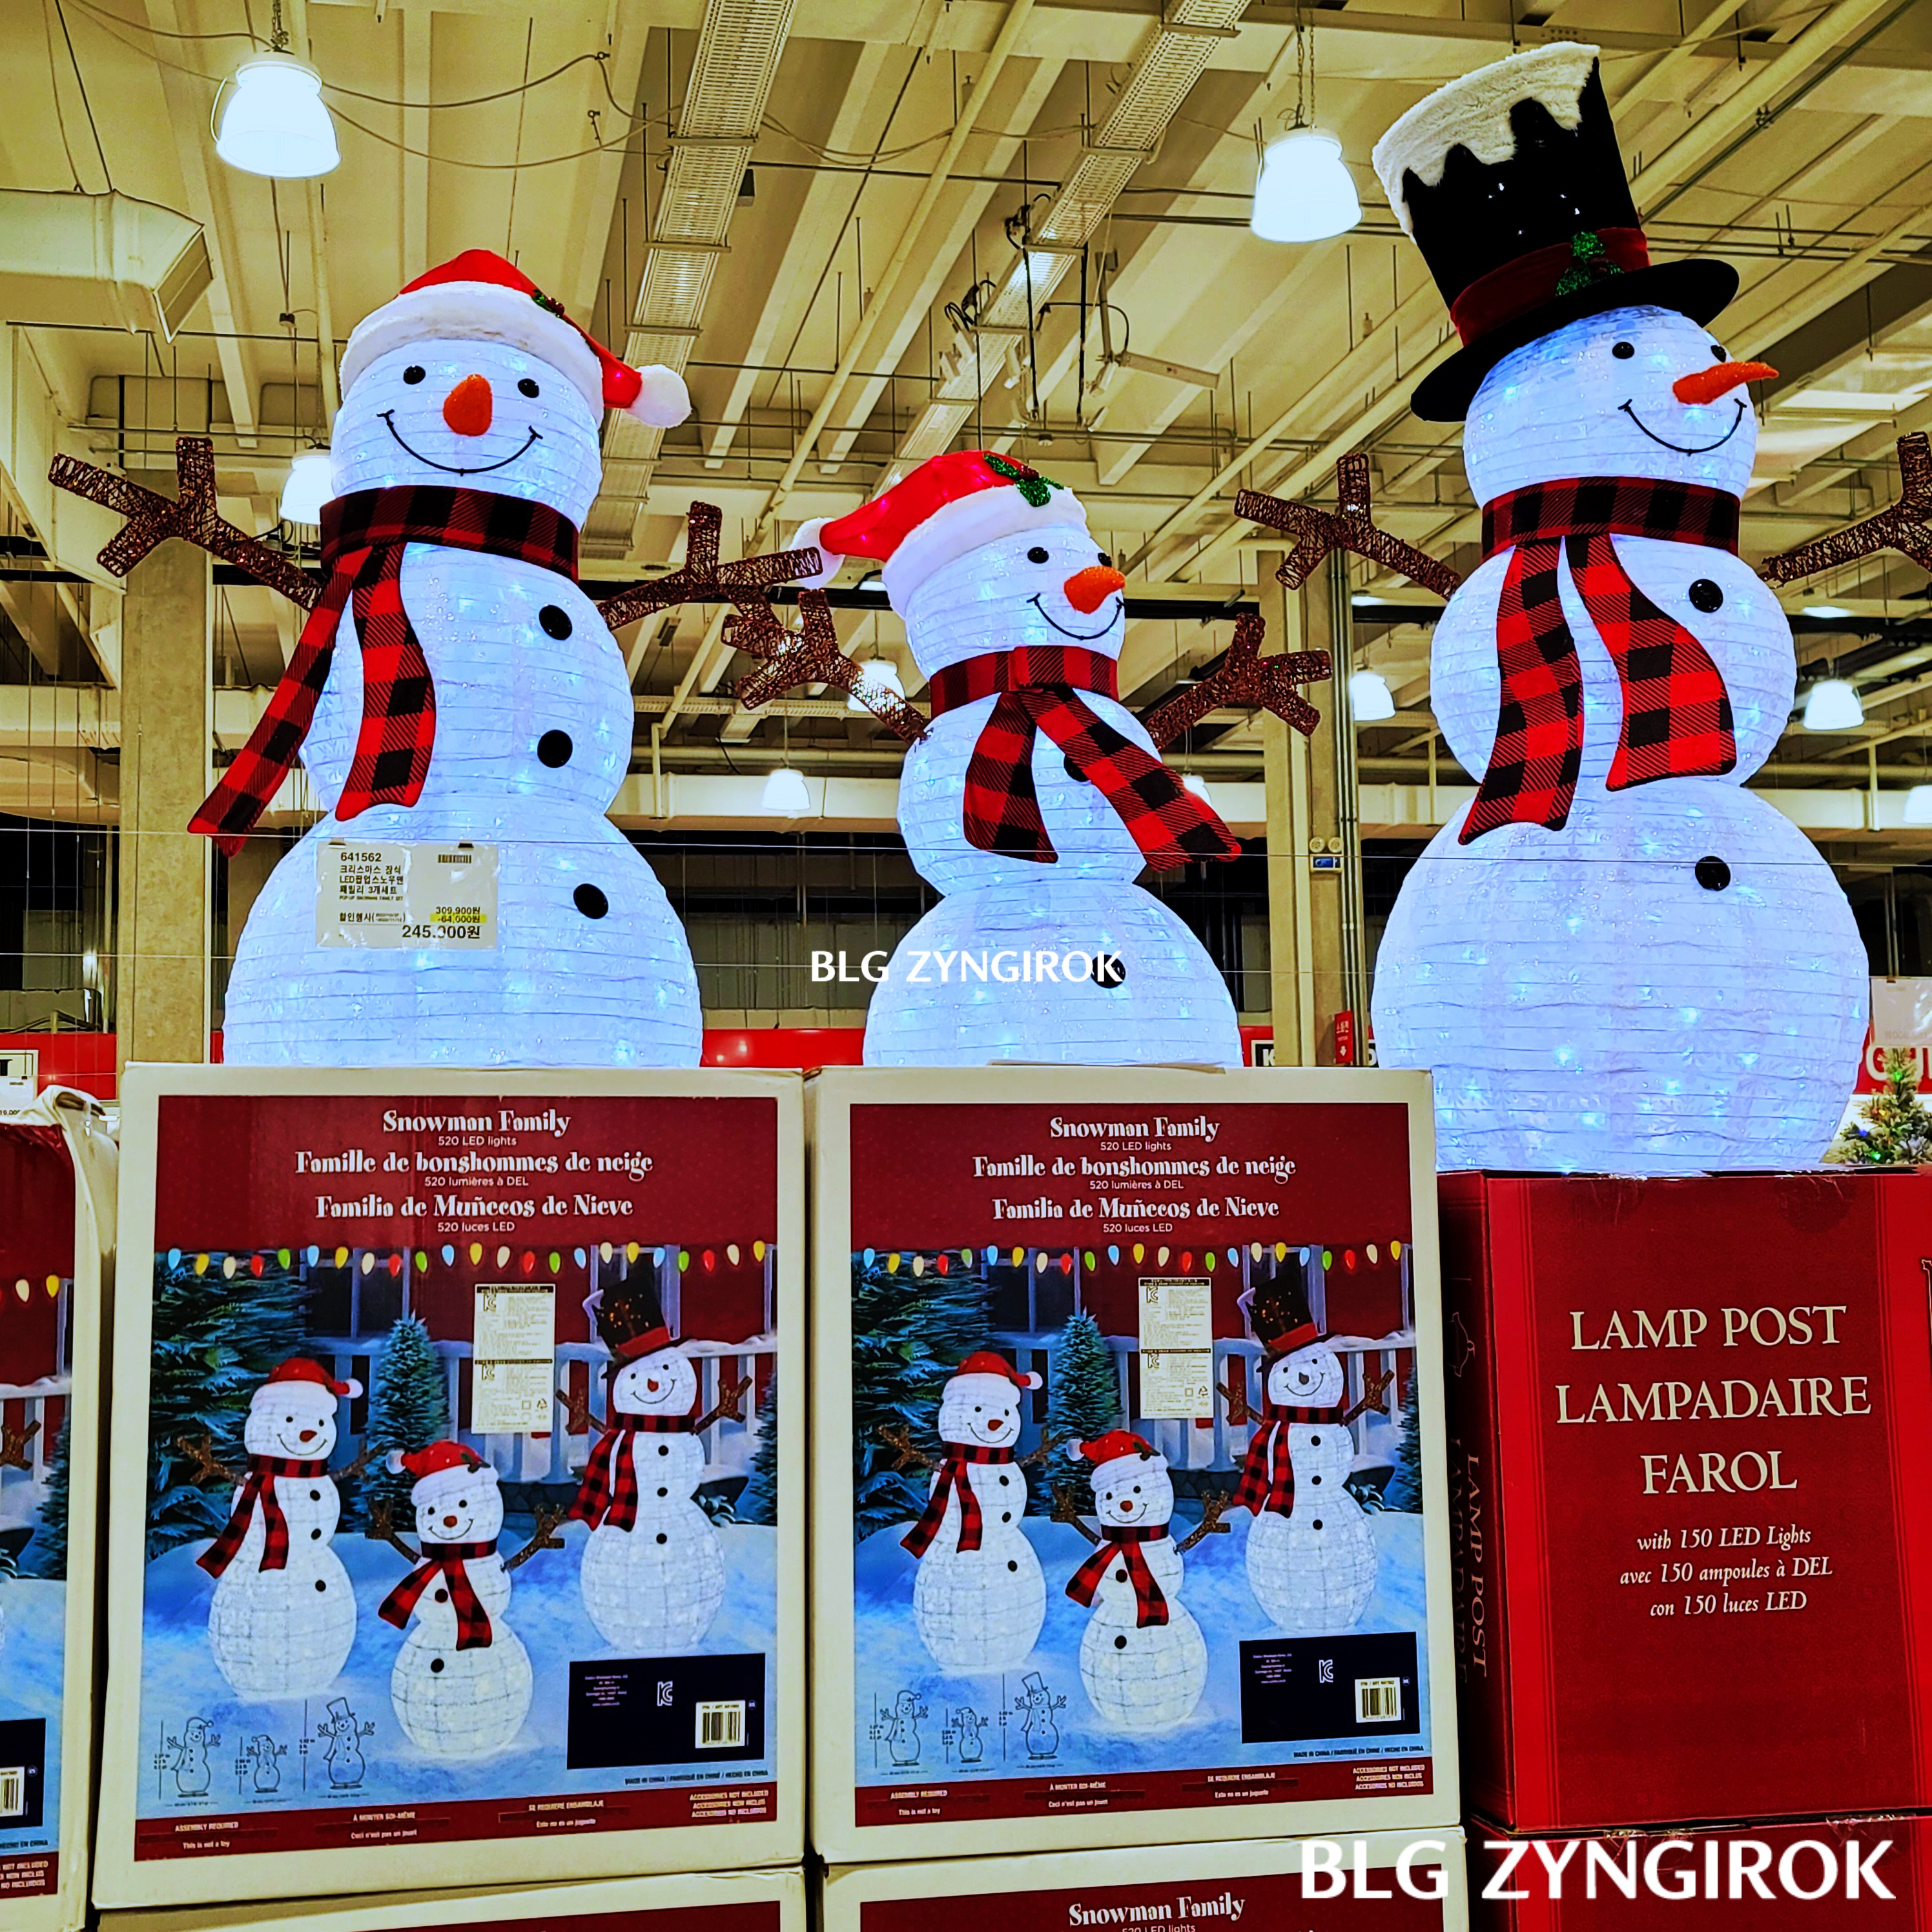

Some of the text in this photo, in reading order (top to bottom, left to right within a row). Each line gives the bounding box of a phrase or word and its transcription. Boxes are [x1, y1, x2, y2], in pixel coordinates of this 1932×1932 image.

[340, 852, 382, 862] 641562
[340, 865, 381, 874] 크리스마스
[436, 907, 480, 915] 309,900원
[384, 1109, 571, 1137] Snowman Family
[1050, 1116, 1220, 1142] Snowman Family
[438, 1136, 517, 1147] 520 LED lights
[1100, 1142, 1172, 1152] 520 LED lights
[295, 1150, 653, 1181] Famille de bonshommes de neige
[973, 1155, 1296, 1184] Famille de bonshommes de neige
[425, 1177, 529, 1187] 520 lumières à DEL
[1089, 1180, 1184, 1189] 520 lumières à DEL
[315, 1194, 633, 1218] Familia de Muñecos de Nieve
[992, 1197, 1279, 1220] Familia de Muñecos de Nieve
[437, 1222, 515, 1232] 520 luces LED
[1103, 1224, 1173, 1233] 520 luces LED
[1570, 1305, 1847, 1350] LAMP POST
[1555, 1376, 1872, 1424] LAMPADAIRE
[1640, 1451, 1798, 1494] FAROL
[1637, 1524, 1811, 1551] with 150 LED Lights
[1467, 1452, 1487, 1678] LAMP POST
[1619, 1556, 1833, 1587] avec 150 ampoules à DEL
[1650, 1590, 1807, 1617] con 150 luces LED
[1069, 1892, 1246, 1926] Snowman Family
